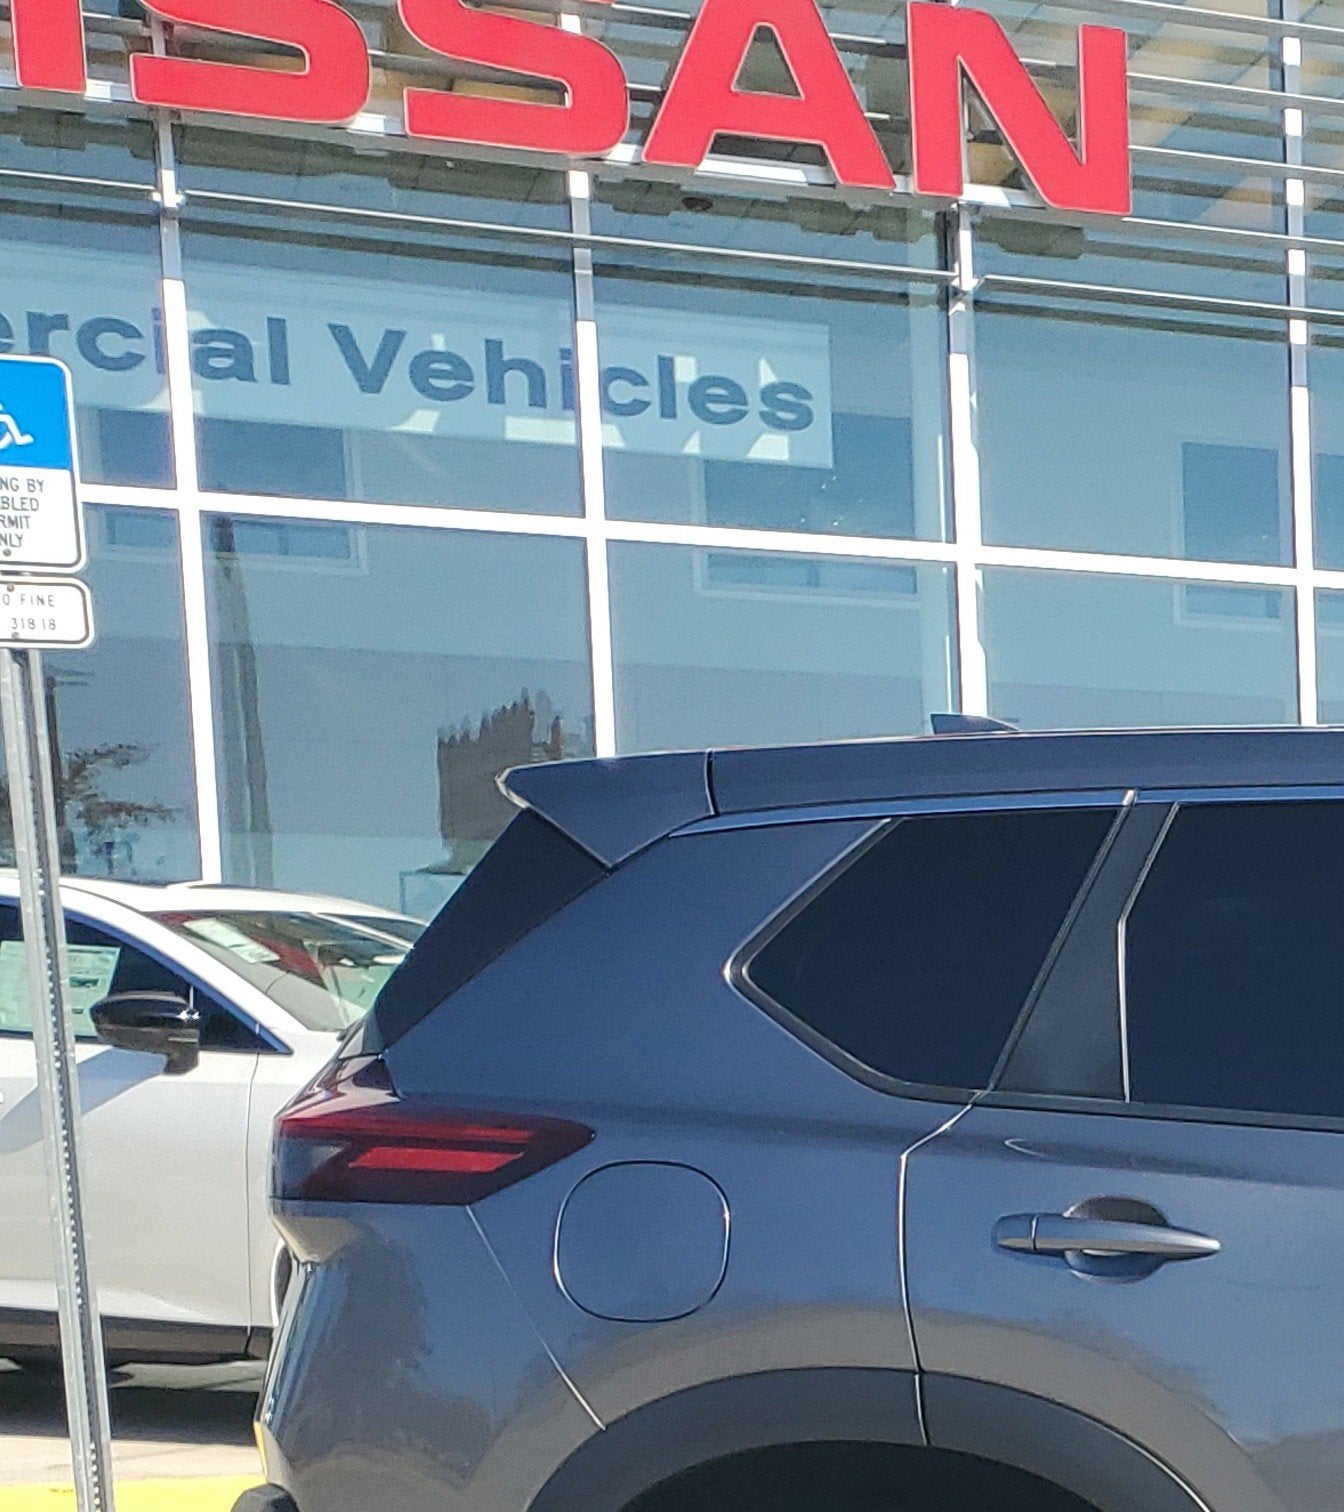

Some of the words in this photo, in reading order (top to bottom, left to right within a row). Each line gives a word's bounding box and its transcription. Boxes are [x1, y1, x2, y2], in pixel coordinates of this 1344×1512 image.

[0, 307, 291, 386] rcial
[328, 323, 814, 431] Vehicles
[27, 478, 44, 493] BY
[20, 595, 55, 608] FINE
